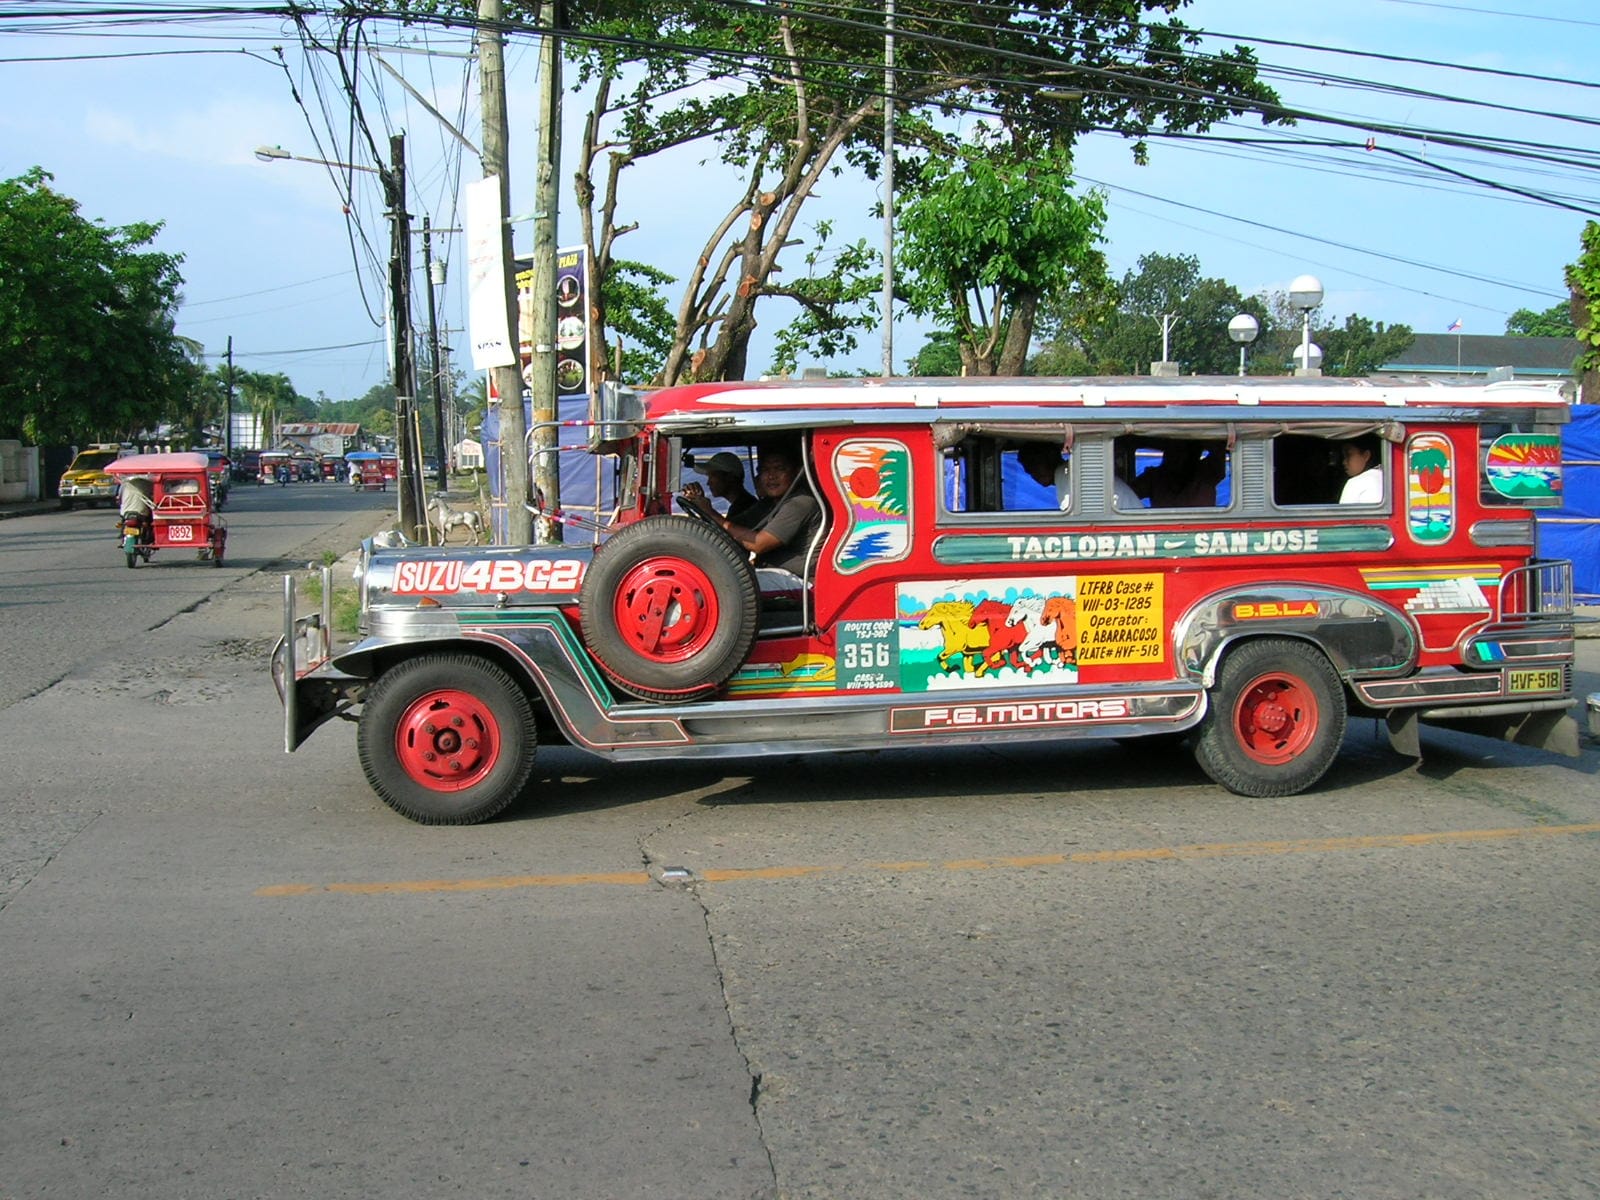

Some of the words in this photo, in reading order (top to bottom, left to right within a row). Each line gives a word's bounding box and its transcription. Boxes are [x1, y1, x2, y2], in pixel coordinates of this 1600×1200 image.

[170, 527, 191, 538] 0892
[1008, 534, 1156, 559] TACLOBAN
[1195, 531, 1248, 554] SAN
[1254, 529, 1318, 551] JOSE
[391, 560, 463, 593] ISUZU
[1080, 581, 1114, 595] LTFRB
[1116, 581, 1142, 594] Case
[1083, 597, 1152, 611] VIII-03-1285
[844, 623, 872, 631] ROUTE
[1093, 628, 1158, 643] ABARRACOSO
[844, 643, 889, 668] 356
[1115, 644, 1159, 658] HVF-518
